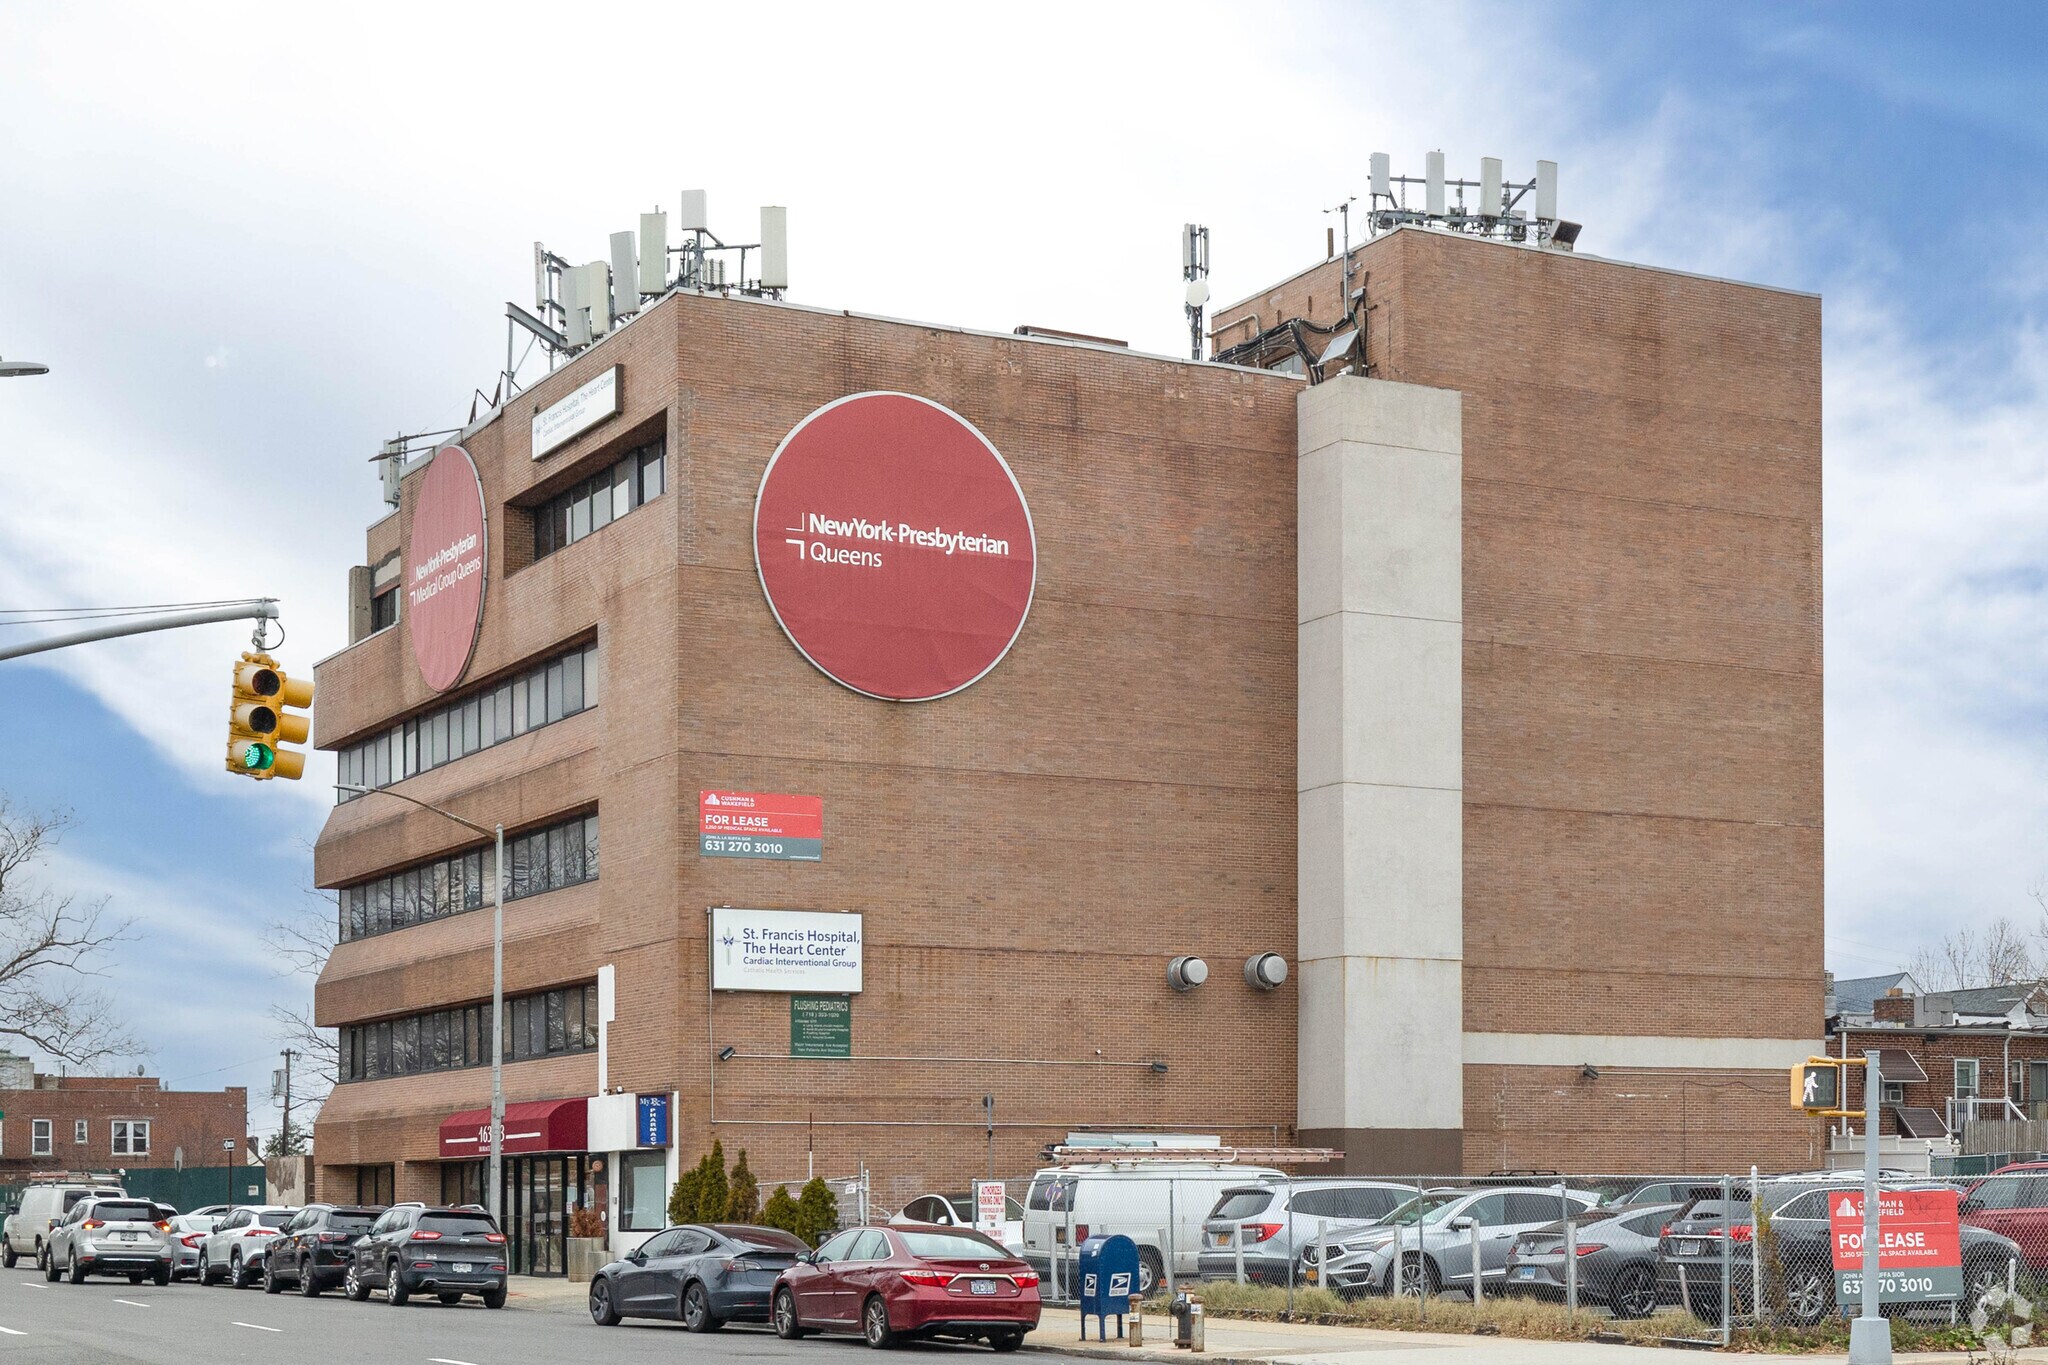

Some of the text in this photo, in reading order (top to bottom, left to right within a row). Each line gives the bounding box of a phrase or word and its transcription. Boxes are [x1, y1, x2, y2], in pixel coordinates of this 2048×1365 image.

[809, 513, 1009, 555] NewYork-Presbyterian
[810, 541, 882, 567] Queens
[416, 556, 481, 604] Medical Group Queens
[705, 814, 768, 827] FOR LEASE
[705, 840, 783, 854] 631 270 3010
[743, 928, 860, 944] St. Francis Hospital,
[743, 942, 846, 956] The Heart Center
[743, 957, 857, 968] Cardiac Interventional Group
[794, 1000, 848, 1011] FLUSHING PEDIATRICS
[1857, 1199, 1904, 1209] CMAN &
[1838, 1233, 1864, 1249] FO
[1842, 1278, 1933, 1294] 63 70 3010
